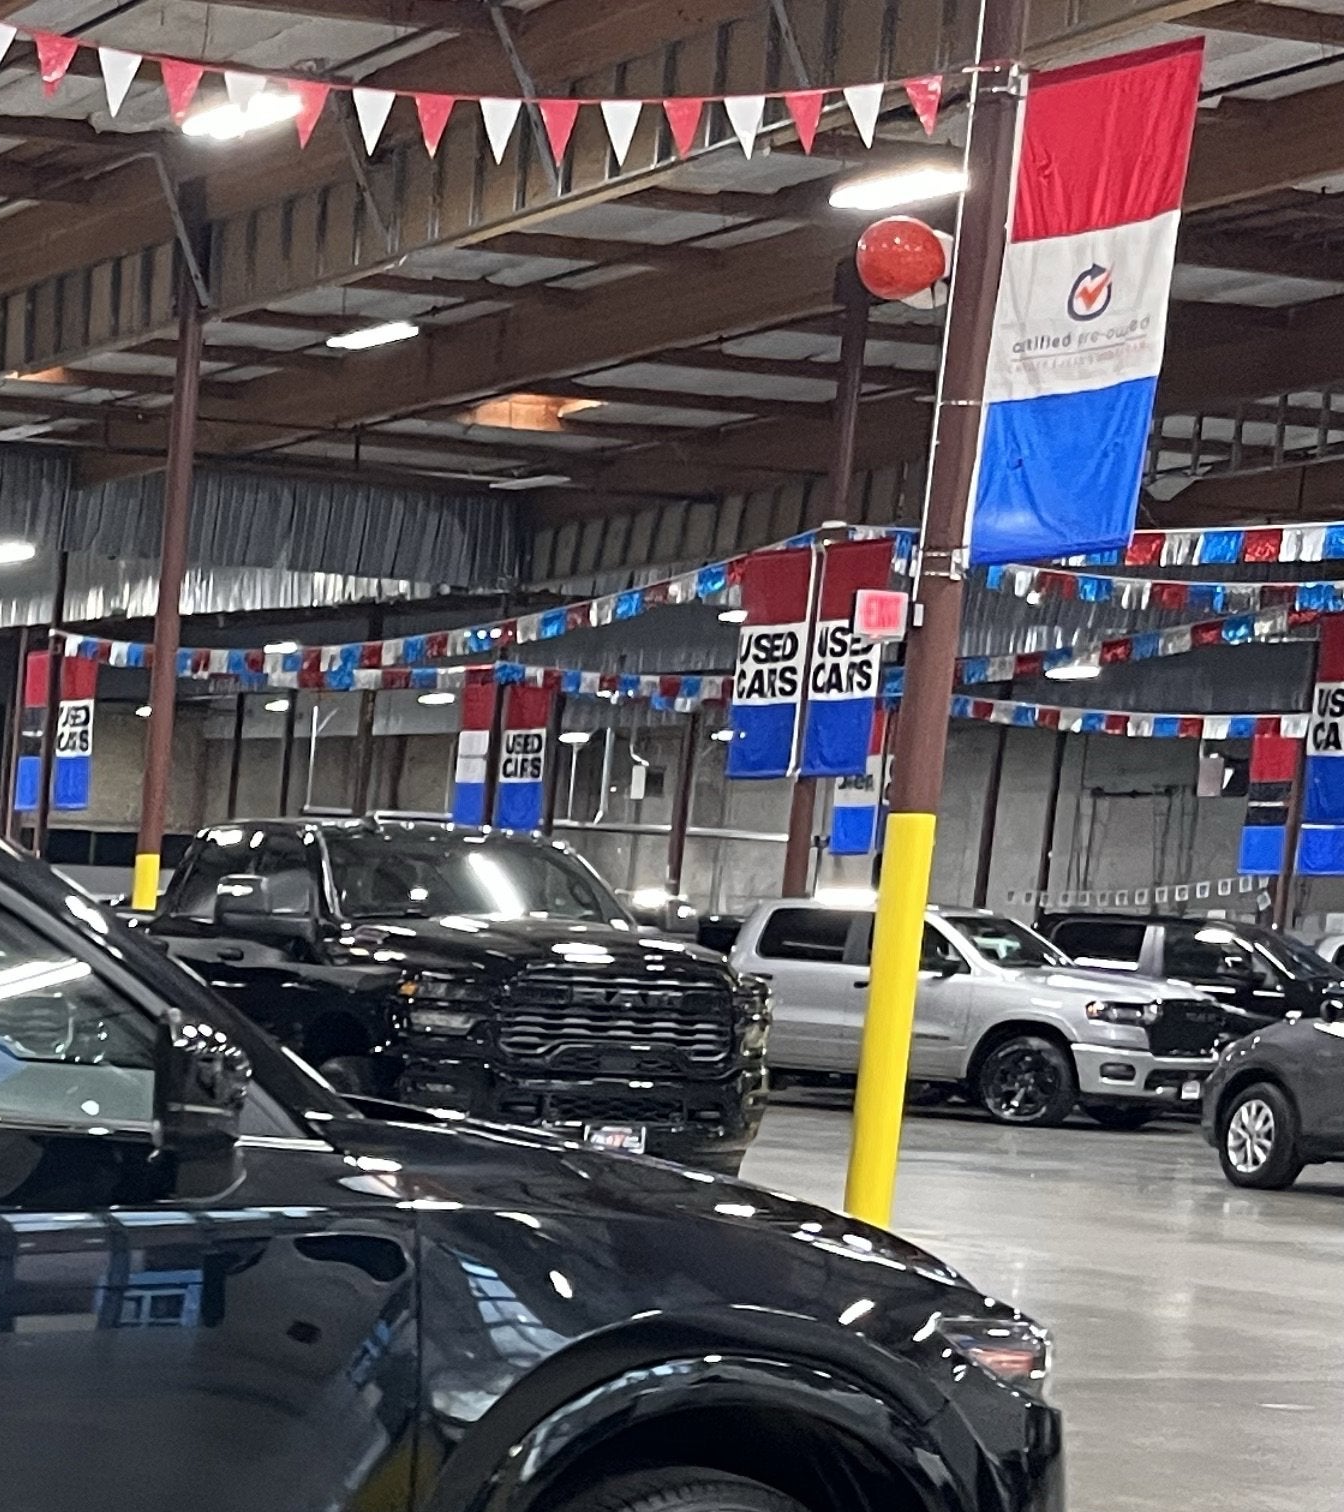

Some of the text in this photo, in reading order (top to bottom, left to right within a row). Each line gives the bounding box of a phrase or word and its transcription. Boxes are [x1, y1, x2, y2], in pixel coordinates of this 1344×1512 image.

[1076, 315, 1151, 348] pre-owed
[739, 631, 800, 665] USED
[817, 626, 874, 658] USE
[736, 666, 799, 699] CARS
[812, 660, 873, 694] CARS
[60, 705, 90, 727] UED
[505, 733, 543, 755] USED
